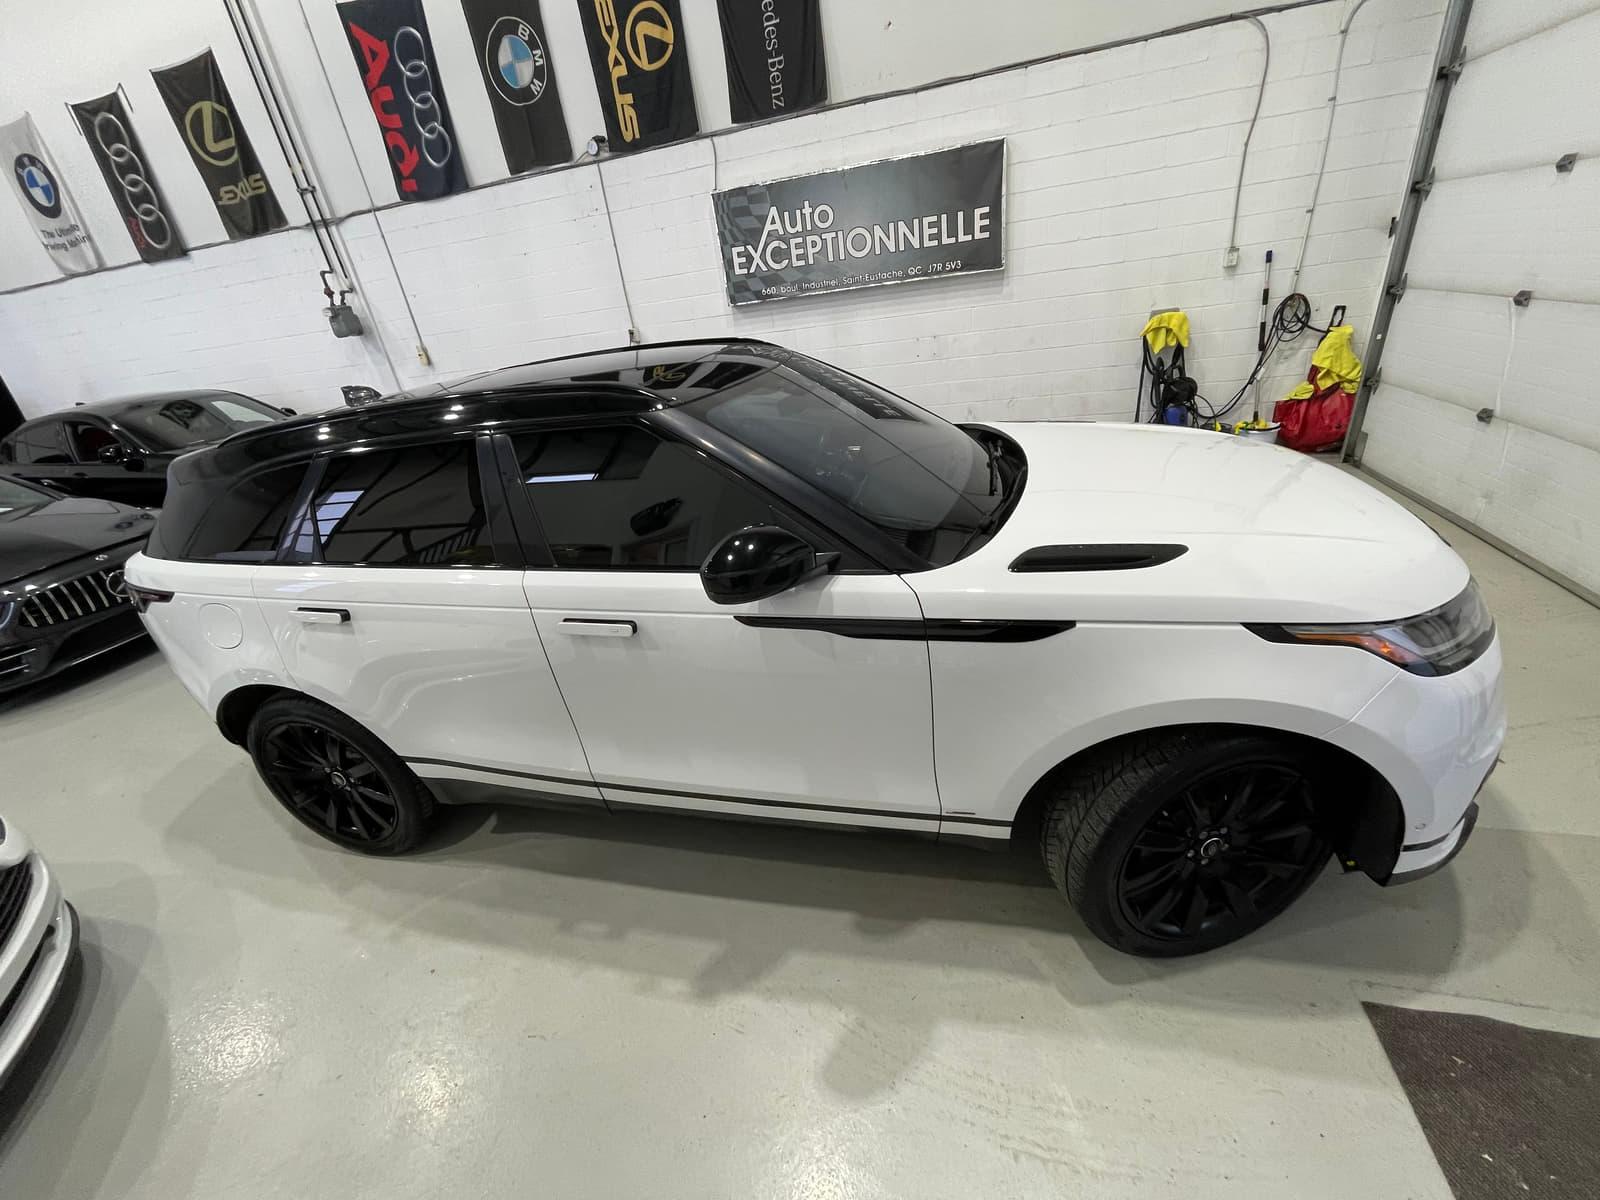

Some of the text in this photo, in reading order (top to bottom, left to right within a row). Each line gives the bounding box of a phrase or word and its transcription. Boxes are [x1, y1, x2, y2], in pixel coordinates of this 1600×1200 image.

[517, 23, 544, 96] BMW
[731, 206, 991, 275] EXCEPTIONNELLE
[763, 200, 835, 236] Auto
[907, 265, 923, 276] QC
[928, 263, 943, 273] J7R
[945, 260, 962, 271] 5V3
